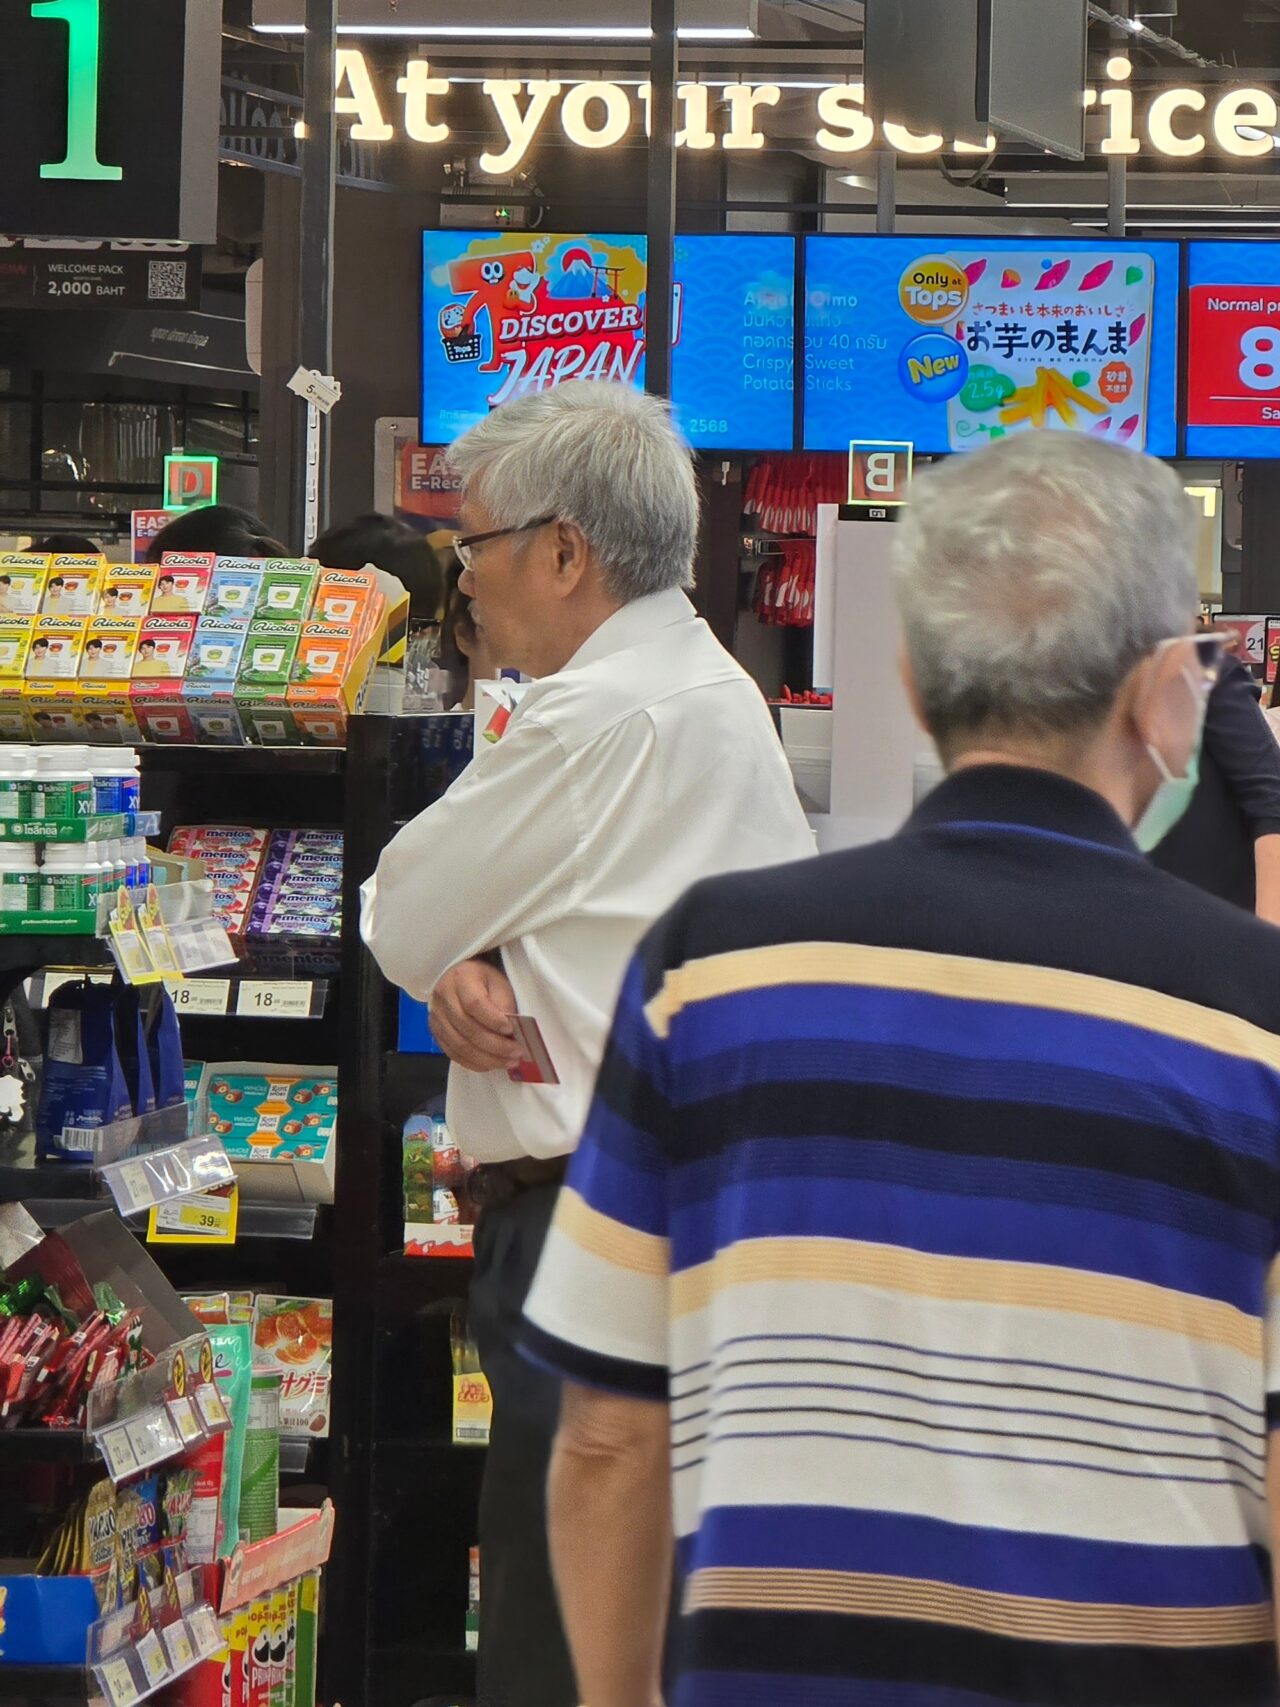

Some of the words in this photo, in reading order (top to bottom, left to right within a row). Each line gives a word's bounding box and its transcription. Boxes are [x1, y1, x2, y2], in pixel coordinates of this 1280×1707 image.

[31, 0, 123, 180] 1
[816, 56, 1278, 158] sice
[48, 263, 97, 274] WELCOME
[98, 264, 124, 275] PACK
[912, 272, 949, 287] Only
[47, 281, 92, 296] 2,000
[95, 285, 125, 296] BAHT
[904, 286, 962, 311] Tops
[1207, 297, 1264, 313] Normal
[499, 305, 640, 341] DISCOVER
[828, 334, 850, 350] 40
[966, 320, 1128, 359] お芋のまんま
[742, 353, 795, 377] Crispy
[804, 353, 856, 371] Sweet
[907, 353, 961, 385] New
[487, 340, 645, 406] JAPAN
[805, 374, 853, 392] Sticks
[178, 466, 204, 499] D
[1, 555, 45, 566] Ricola
[54, 556, 98, 567] Ricola
[164, 554, 208, 566] Ricola
[217, 559, 261, 571] Ricola
[268, 560, 312, 573] Ricola
[109, 566, 153, 577] Ricola
[324, 572, 369, 585] Ricola
[0, 616, 29, 627] icola
[38, 616, 83, 628] Ricola
[92, 617, 136, 628] Ricola
[145, 617, 191, 629] Ricola
[199, 619, 244, 631] Ricola
[252, 620, 296, 633] Ricola
[305, 623, 350, 636] Ricola
[206, 829, 251, 838] mentos
[306, 833, 344, 842] mento
[200, 851, 246, 859] mentos
[300, 854, 344, 863] mento
[205, 872, 240, 880] entos
[291, 875, 339, 883] mentos
[286, 895, 332, 903] mentos
[281, 916, 328, 924] mentos
[170, 990, 191, 1004] 18
[253, 992, 274, 1007] 18
